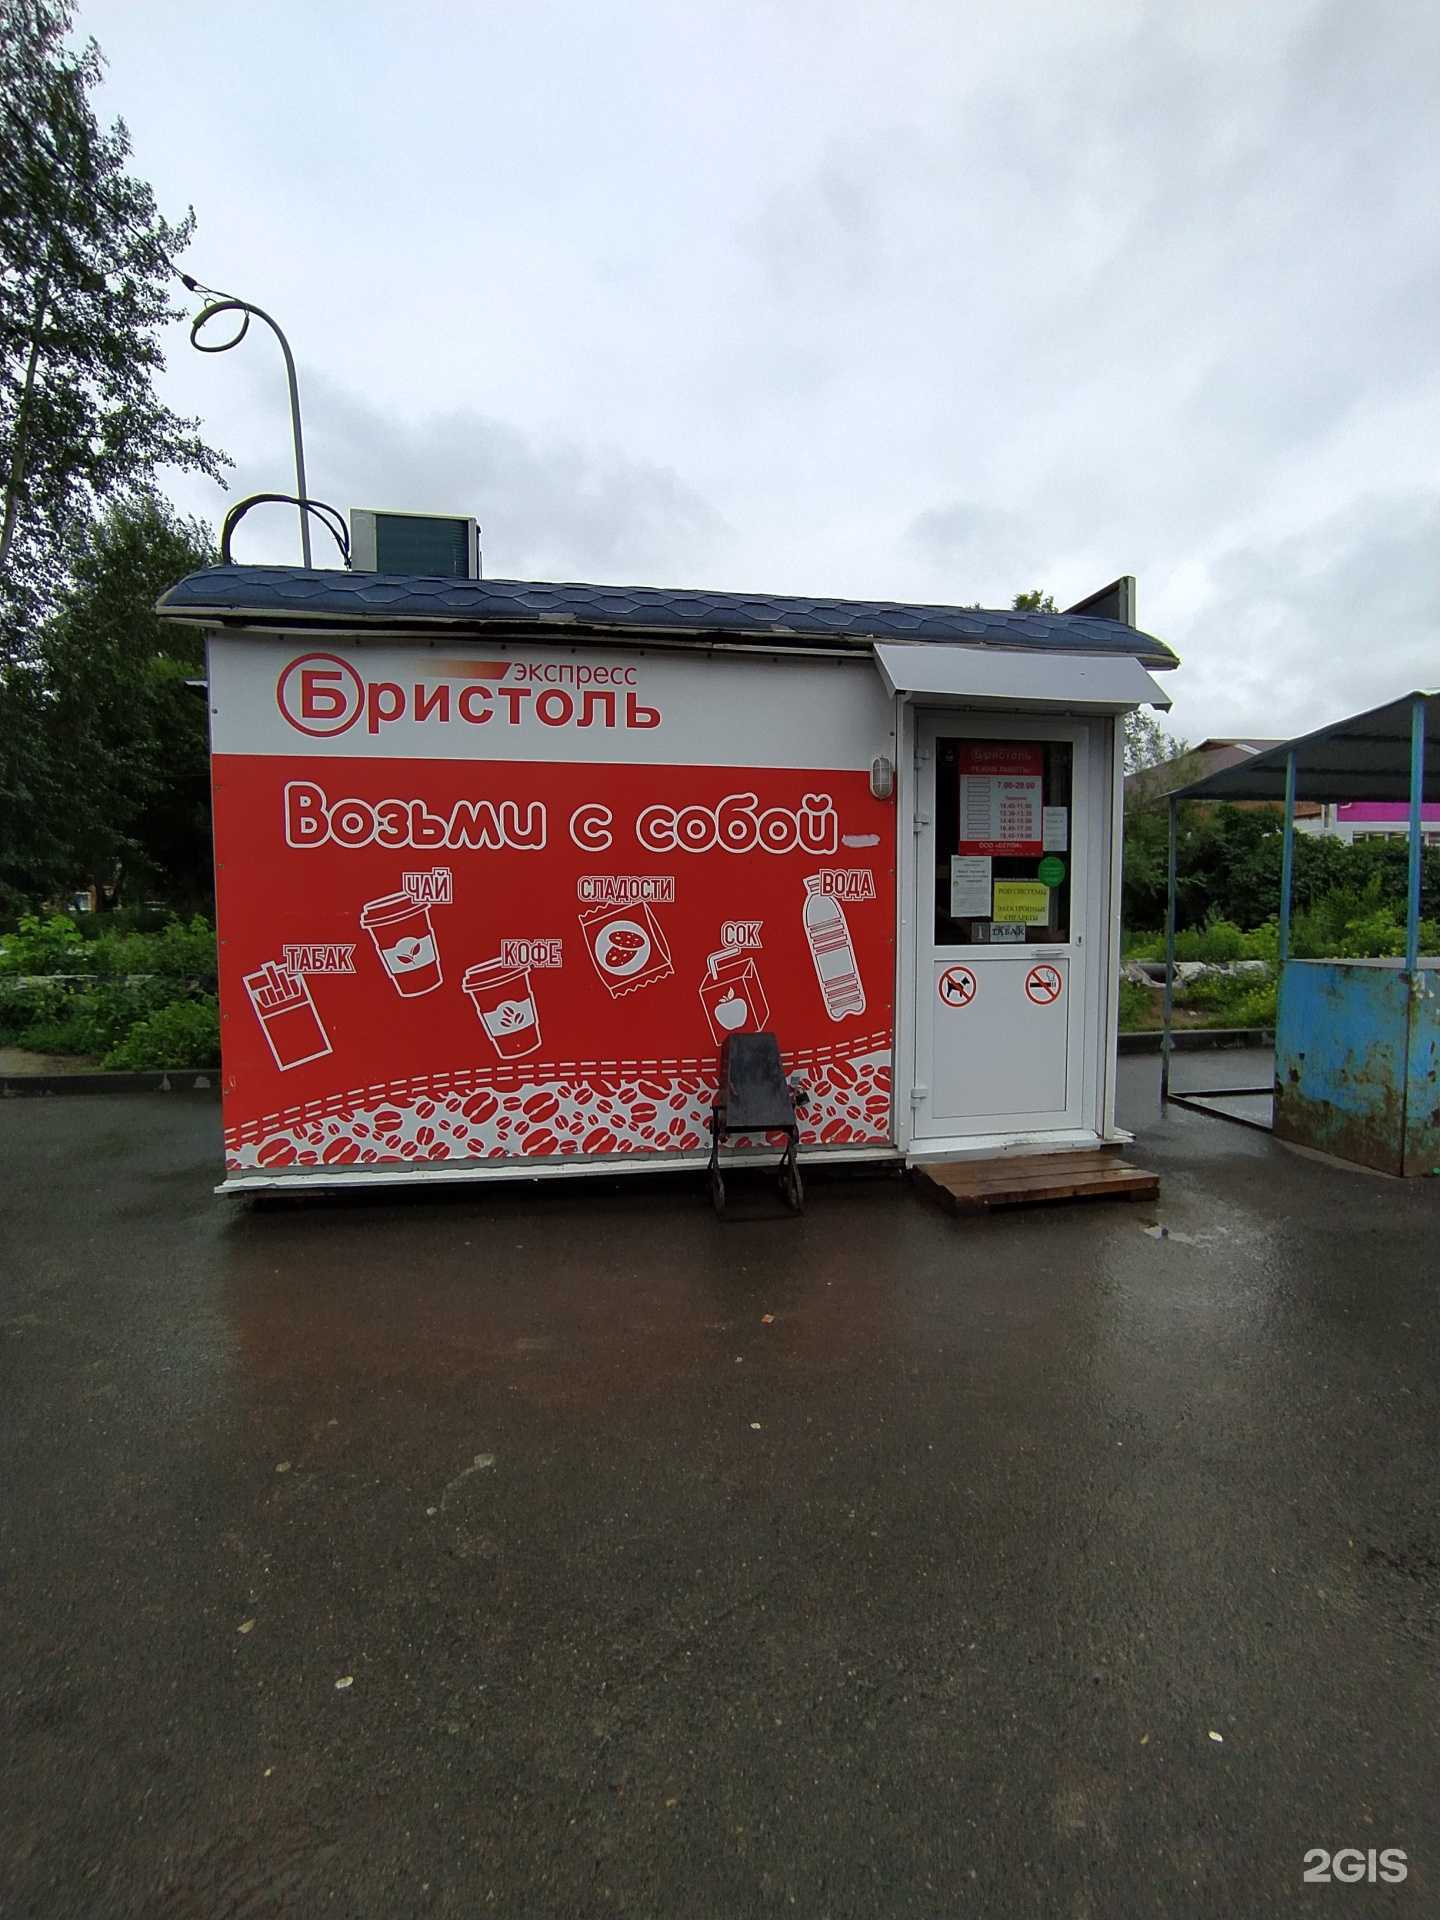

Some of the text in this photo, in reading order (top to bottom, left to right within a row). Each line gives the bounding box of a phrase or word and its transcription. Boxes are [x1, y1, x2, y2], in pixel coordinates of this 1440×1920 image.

[513, 662, 638, 690] экспресс
[292, 664, 662, 736] Бристоль
[284, 781, 838, 854] Возьми с собой
[403, 868, 452, 903] ЧАЙ
[578, 877, 674, 902] СЛАДОСТИ
[820, 870, 875, 900] ВОДА
[721, 921, 763, 948] СОК
[284, 945, 355, 973] ТАБАК
[501, 940, 562, 967] КОФЕ
